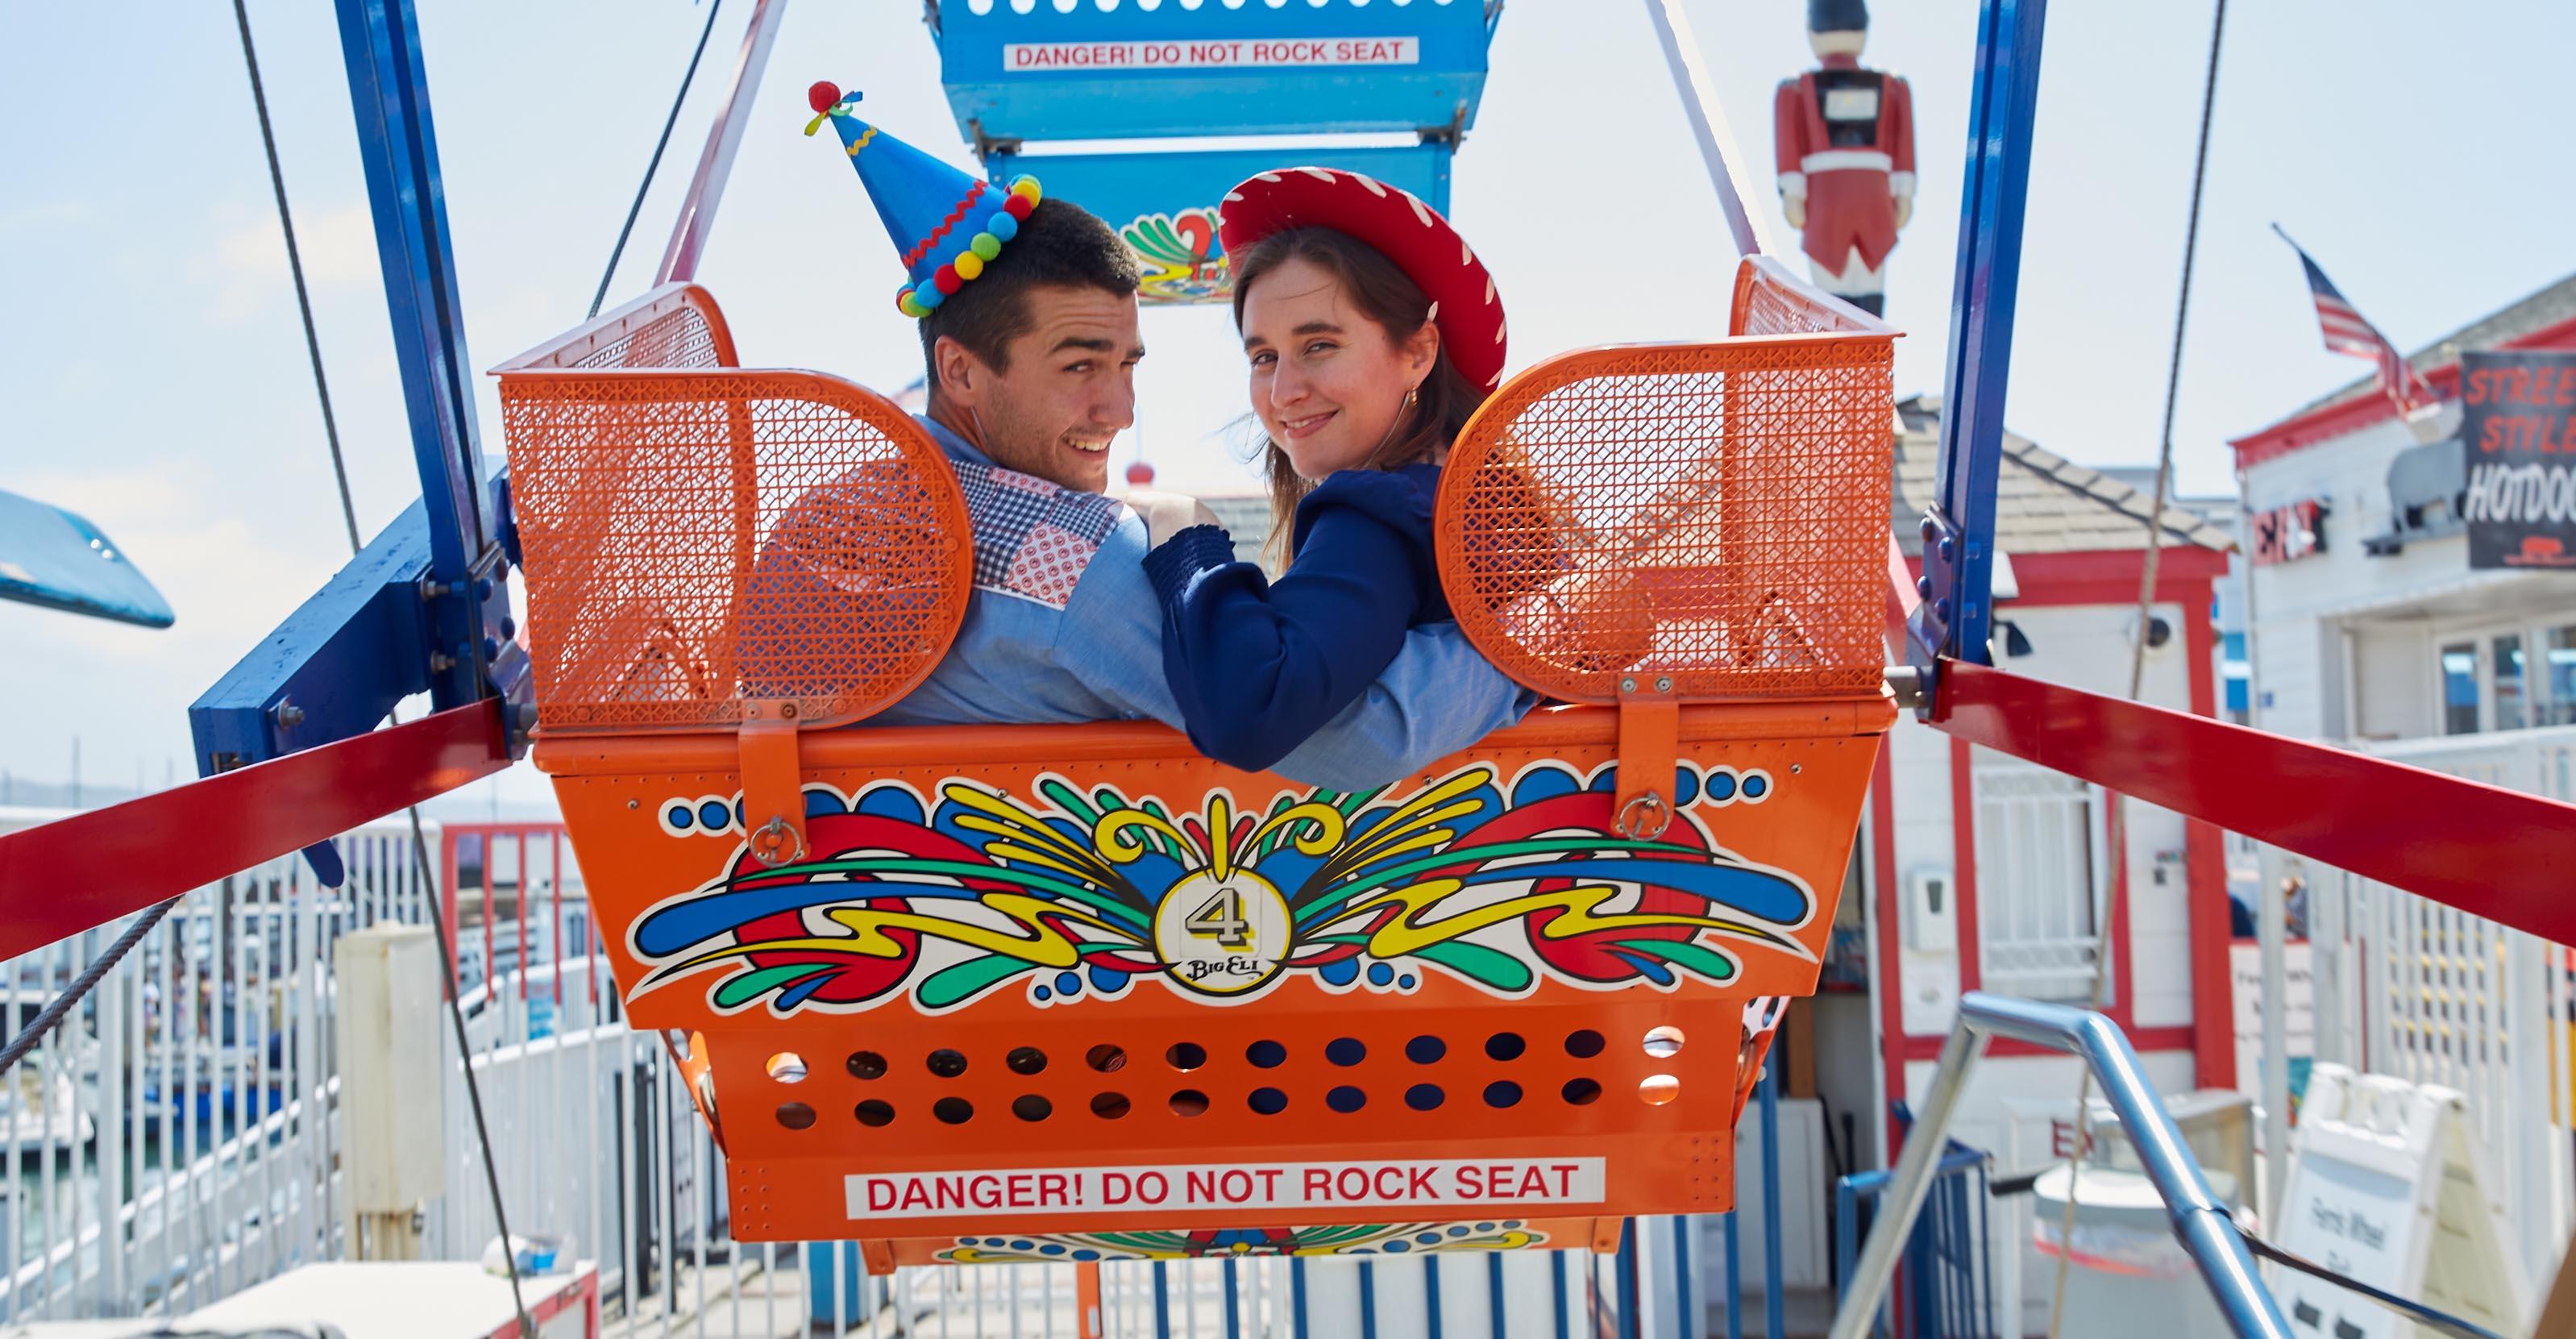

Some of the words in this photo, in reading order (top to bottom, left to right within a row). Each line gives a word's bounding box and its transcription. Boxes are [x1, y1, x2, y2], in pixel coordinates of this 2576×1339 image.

[1016, 45, 1133, 66] DANGER!
[1145, 44, 1180, 64] DO
[1190, 43, 1242, 63] NOT
[1253, 42, 1327, 62] ROCK
[1336, 41, 1403, 60] SEAT
[1185, 888, 1252, 949] 4
[867, 1174, 1082, 1211] DANGER!
[1103, 1171, 1169, 1204] DO
[1186, 1170, 1283, 1203] NOT
[1303, 1166, 1440, 1200] ROCK
[1456, 1165, 1579, 1199] SEAT
